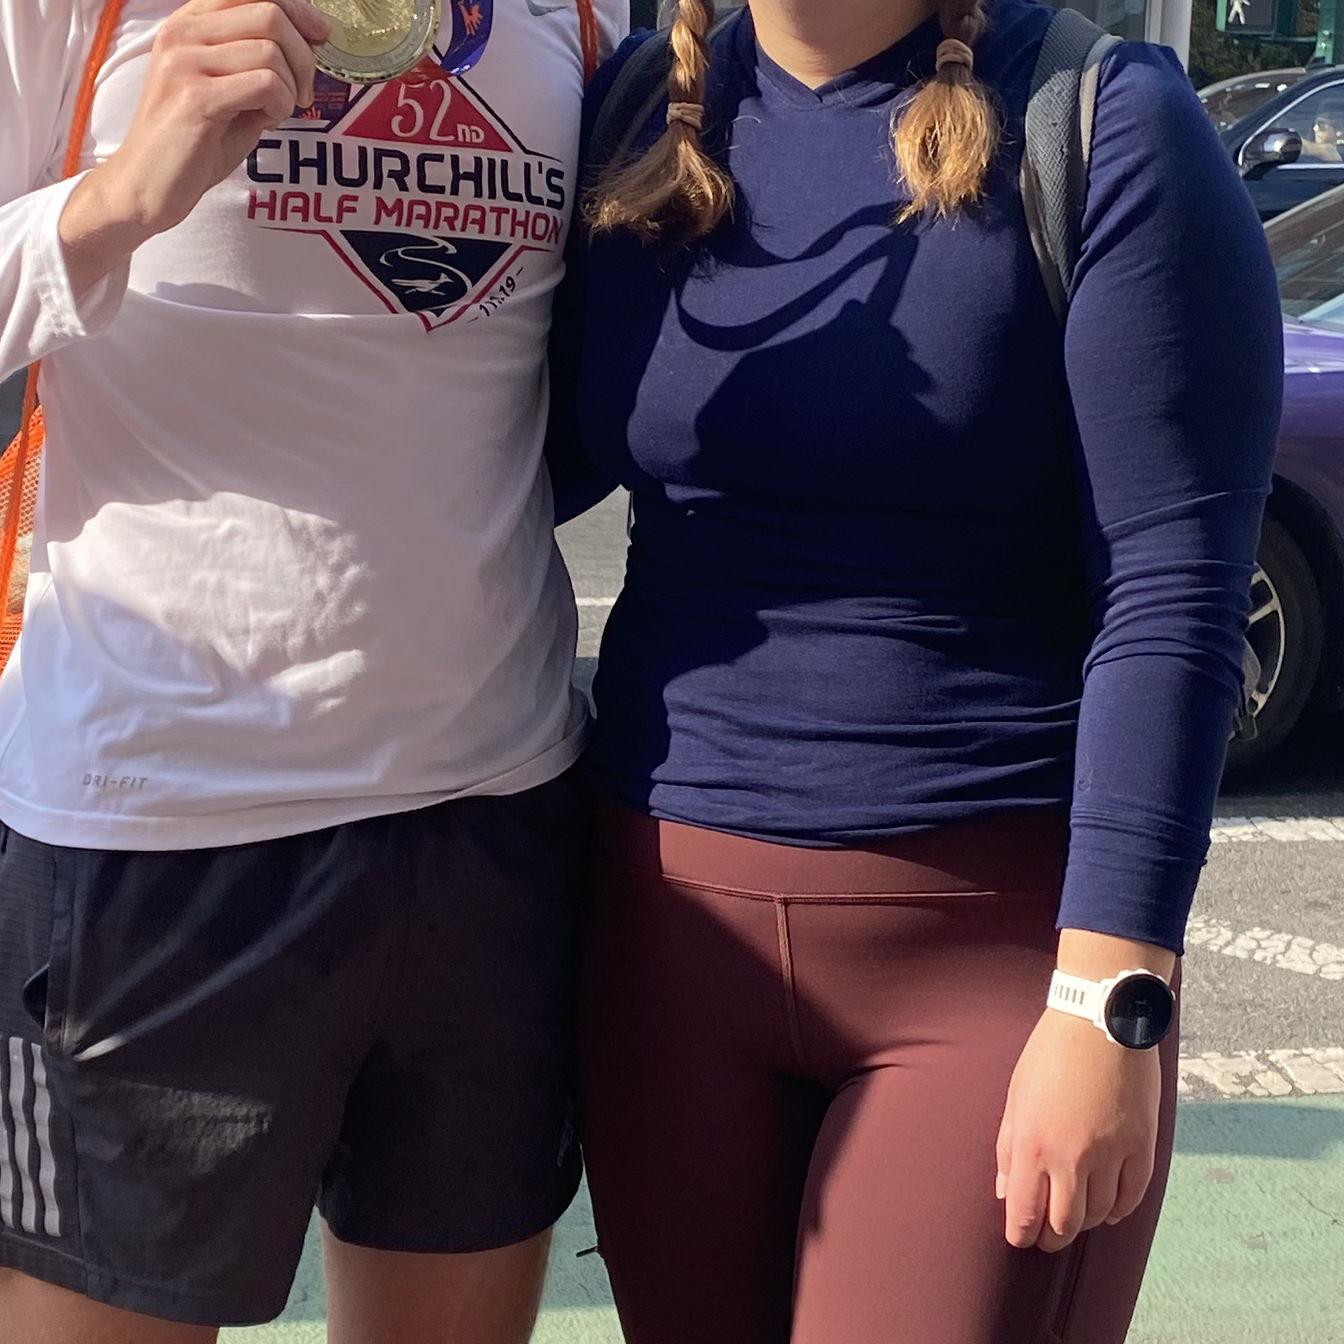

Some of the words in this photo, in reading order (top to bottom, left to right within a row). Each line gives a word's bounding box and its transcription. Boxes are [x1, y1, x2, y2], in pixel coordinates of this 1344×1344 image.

[246, 139, 565, 211] CHURCHILL'S
[247, 188, 360, 224] HALF
[373, 195, 563, 244] MARATHON
[82, 773, 149, 790] DRI-FIT
